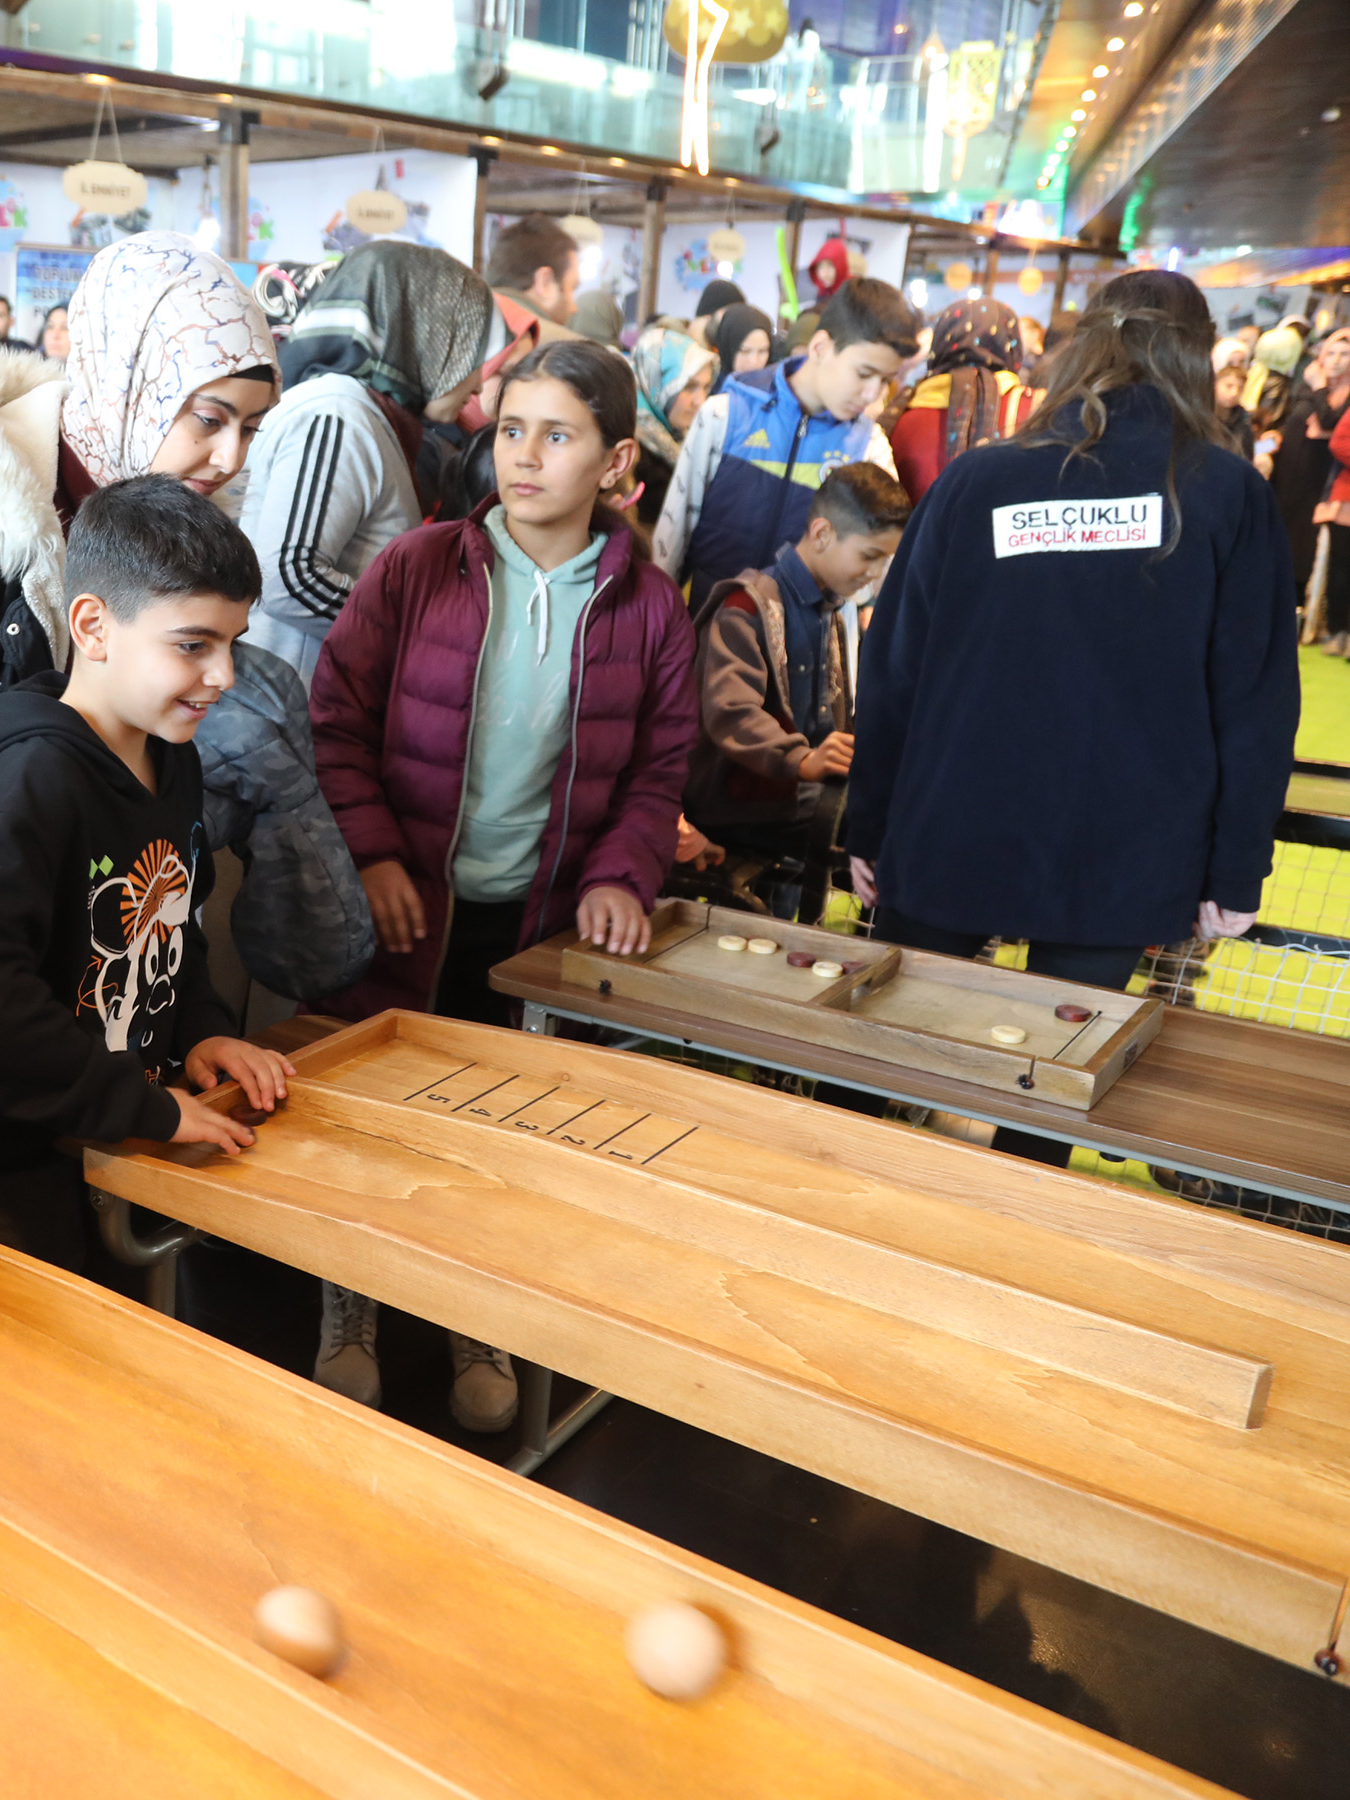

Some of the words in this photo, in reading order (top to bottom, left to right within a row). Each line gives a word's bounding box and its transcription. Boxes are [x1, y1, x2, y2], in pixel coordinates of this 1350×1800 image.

[1012, 504, 1148, 530] SELÇUKLU
[1008, 527, 1077, 548] GENÇLİK
[1081, 525, 1146, 543] MECLİSİ
[426, 1092, 451, 1104] 5
[469, 1107, 492, 1117] 4
[514, 1120, 539, 1131] 3
[560, 1134, 585, 1146] 2
[608, 1150, 632, 1160] 1
